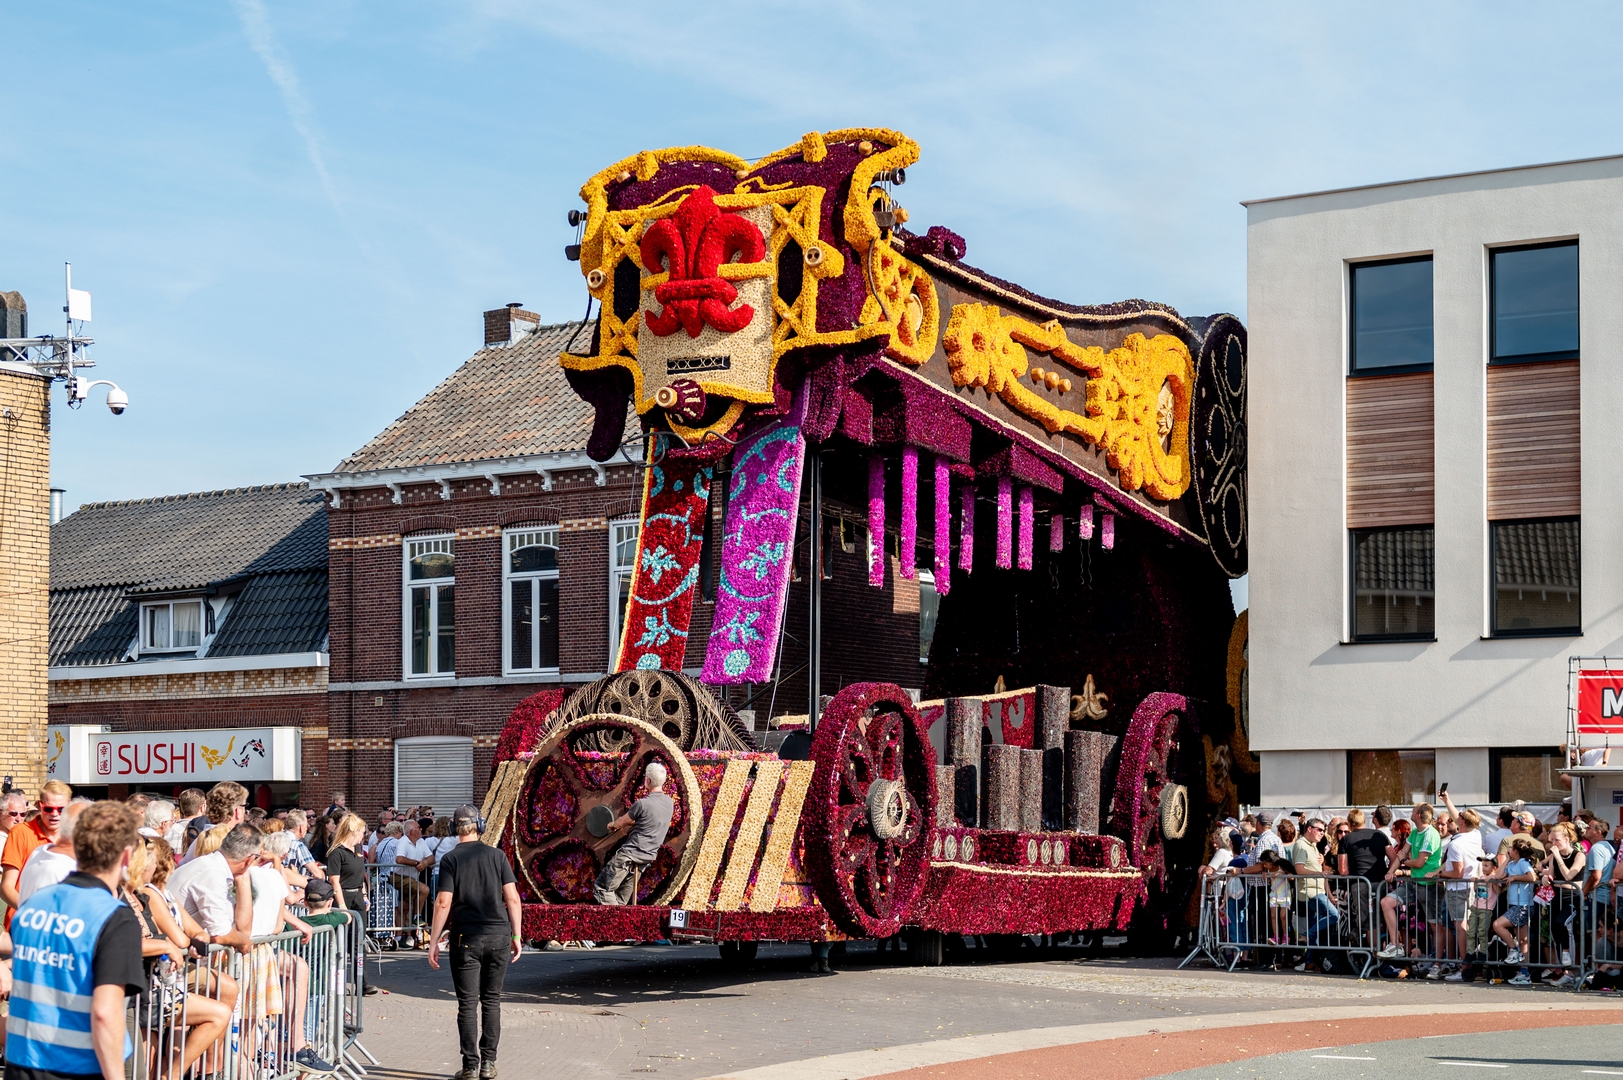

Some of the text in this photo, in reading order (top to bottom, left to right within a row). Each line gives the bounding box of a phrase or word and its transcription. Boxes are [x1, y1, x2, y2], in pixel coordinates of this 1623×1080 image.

[117, 742, 195, 775] SUSHI
[19, 907, 85, 939] corso
[673, 911, 684, 922] 19
[14, 944, 75, 971] zundert
